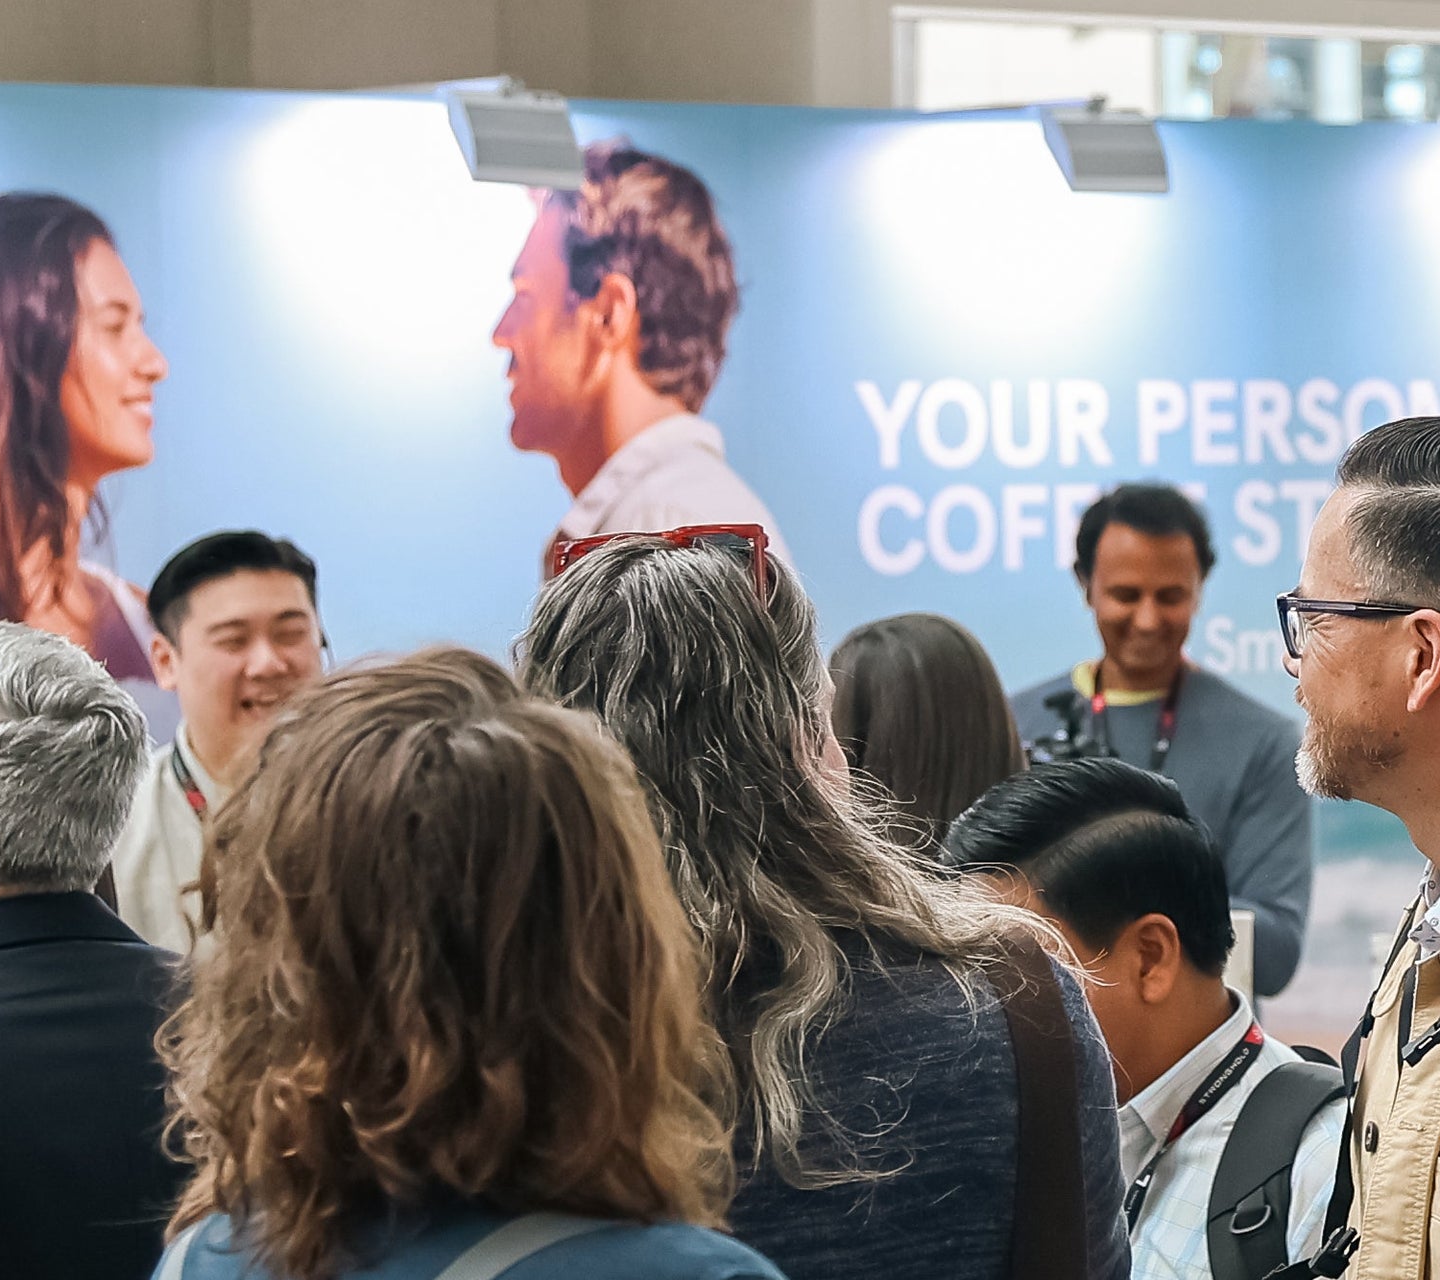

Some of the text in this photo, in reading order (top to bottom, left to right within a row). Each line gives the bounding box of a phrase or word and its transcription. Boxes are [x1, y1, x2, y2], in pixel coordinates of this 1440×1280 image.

[854, 377, 1114, 470] YOUR
[859, 483, 1208, 576] COFF
[1198, 1046, 1251, 1105] STRONGHOLD
